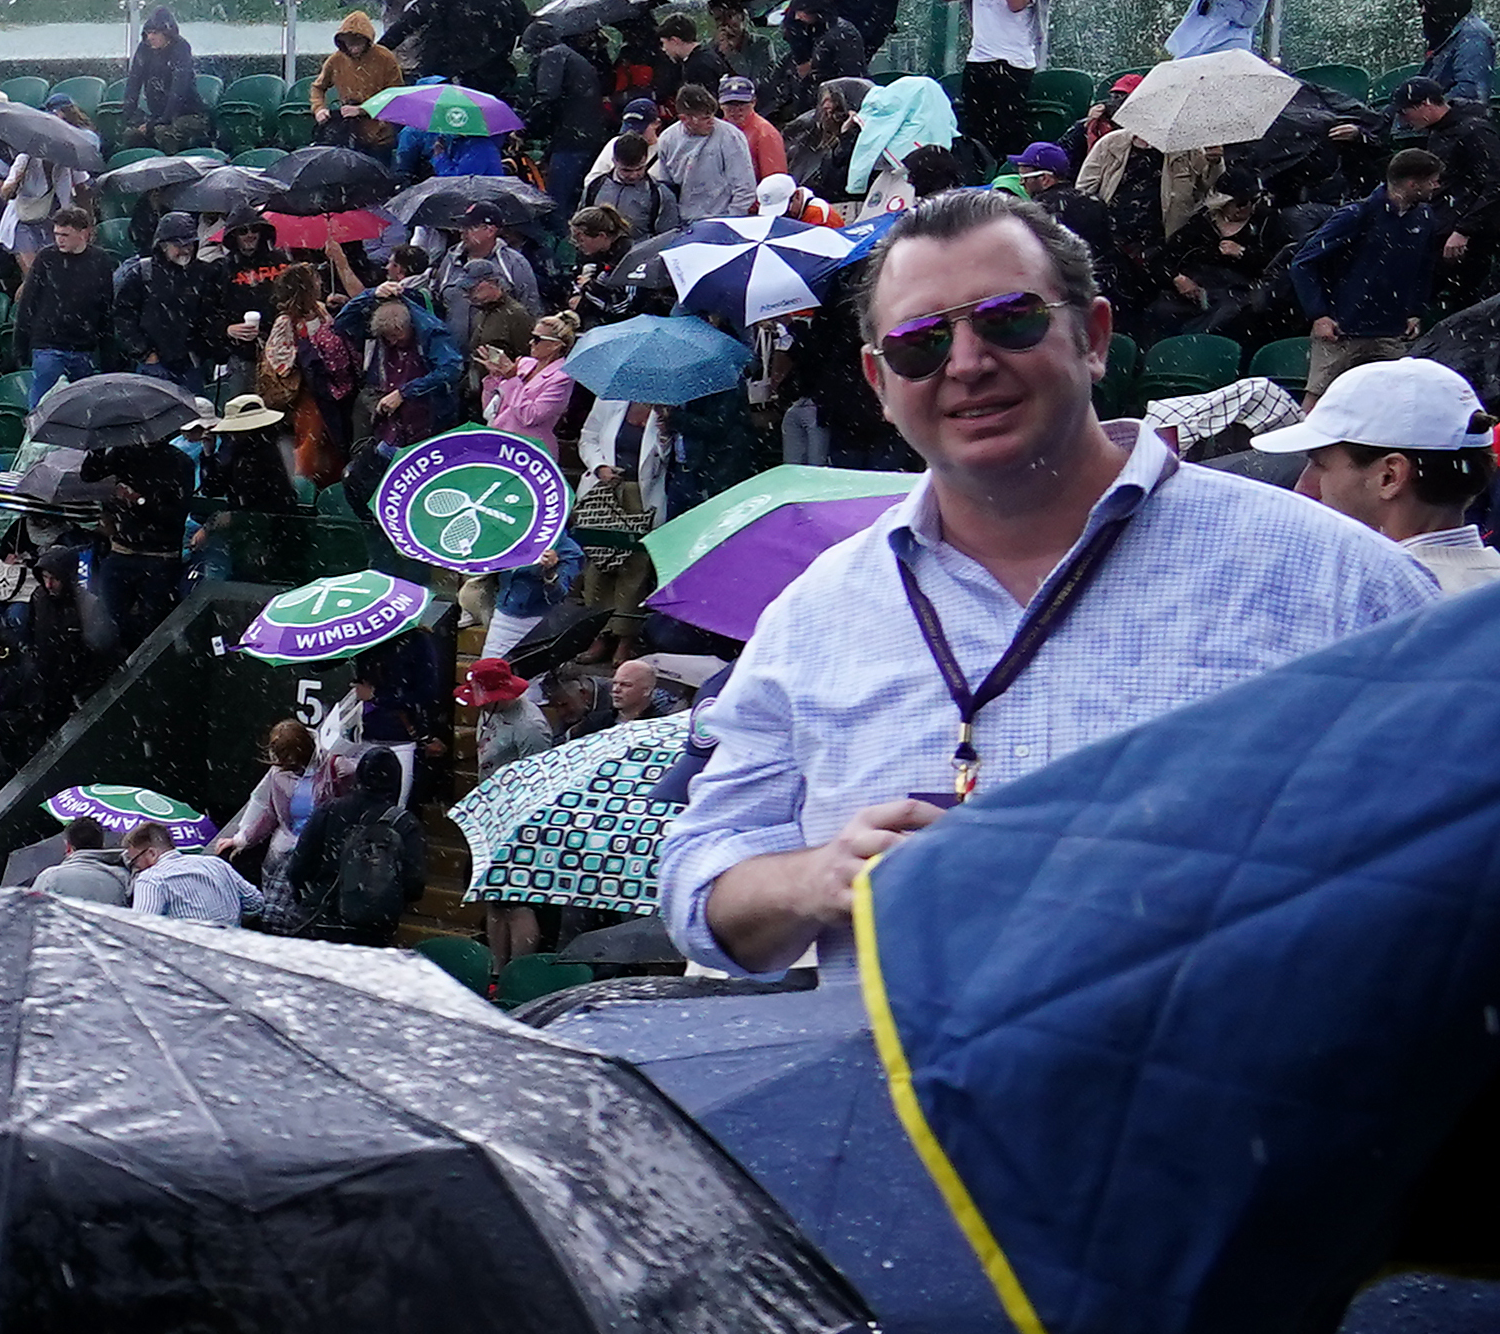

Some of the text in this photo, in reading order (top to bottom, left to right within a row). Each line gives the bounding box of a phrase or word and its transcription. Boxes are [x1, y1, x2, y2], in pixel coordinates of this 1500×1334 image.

[759, 297, 803, 313] Aberdeen
[384, 449, 445, 565] AMPIONSHIPS
[499, 443, 560, 545] WIMBLEDON
[295, 593, 414, 650] WIMBLEDON
[296, 679, 323, 726] 5
[170, 825, 206, 841] THE
